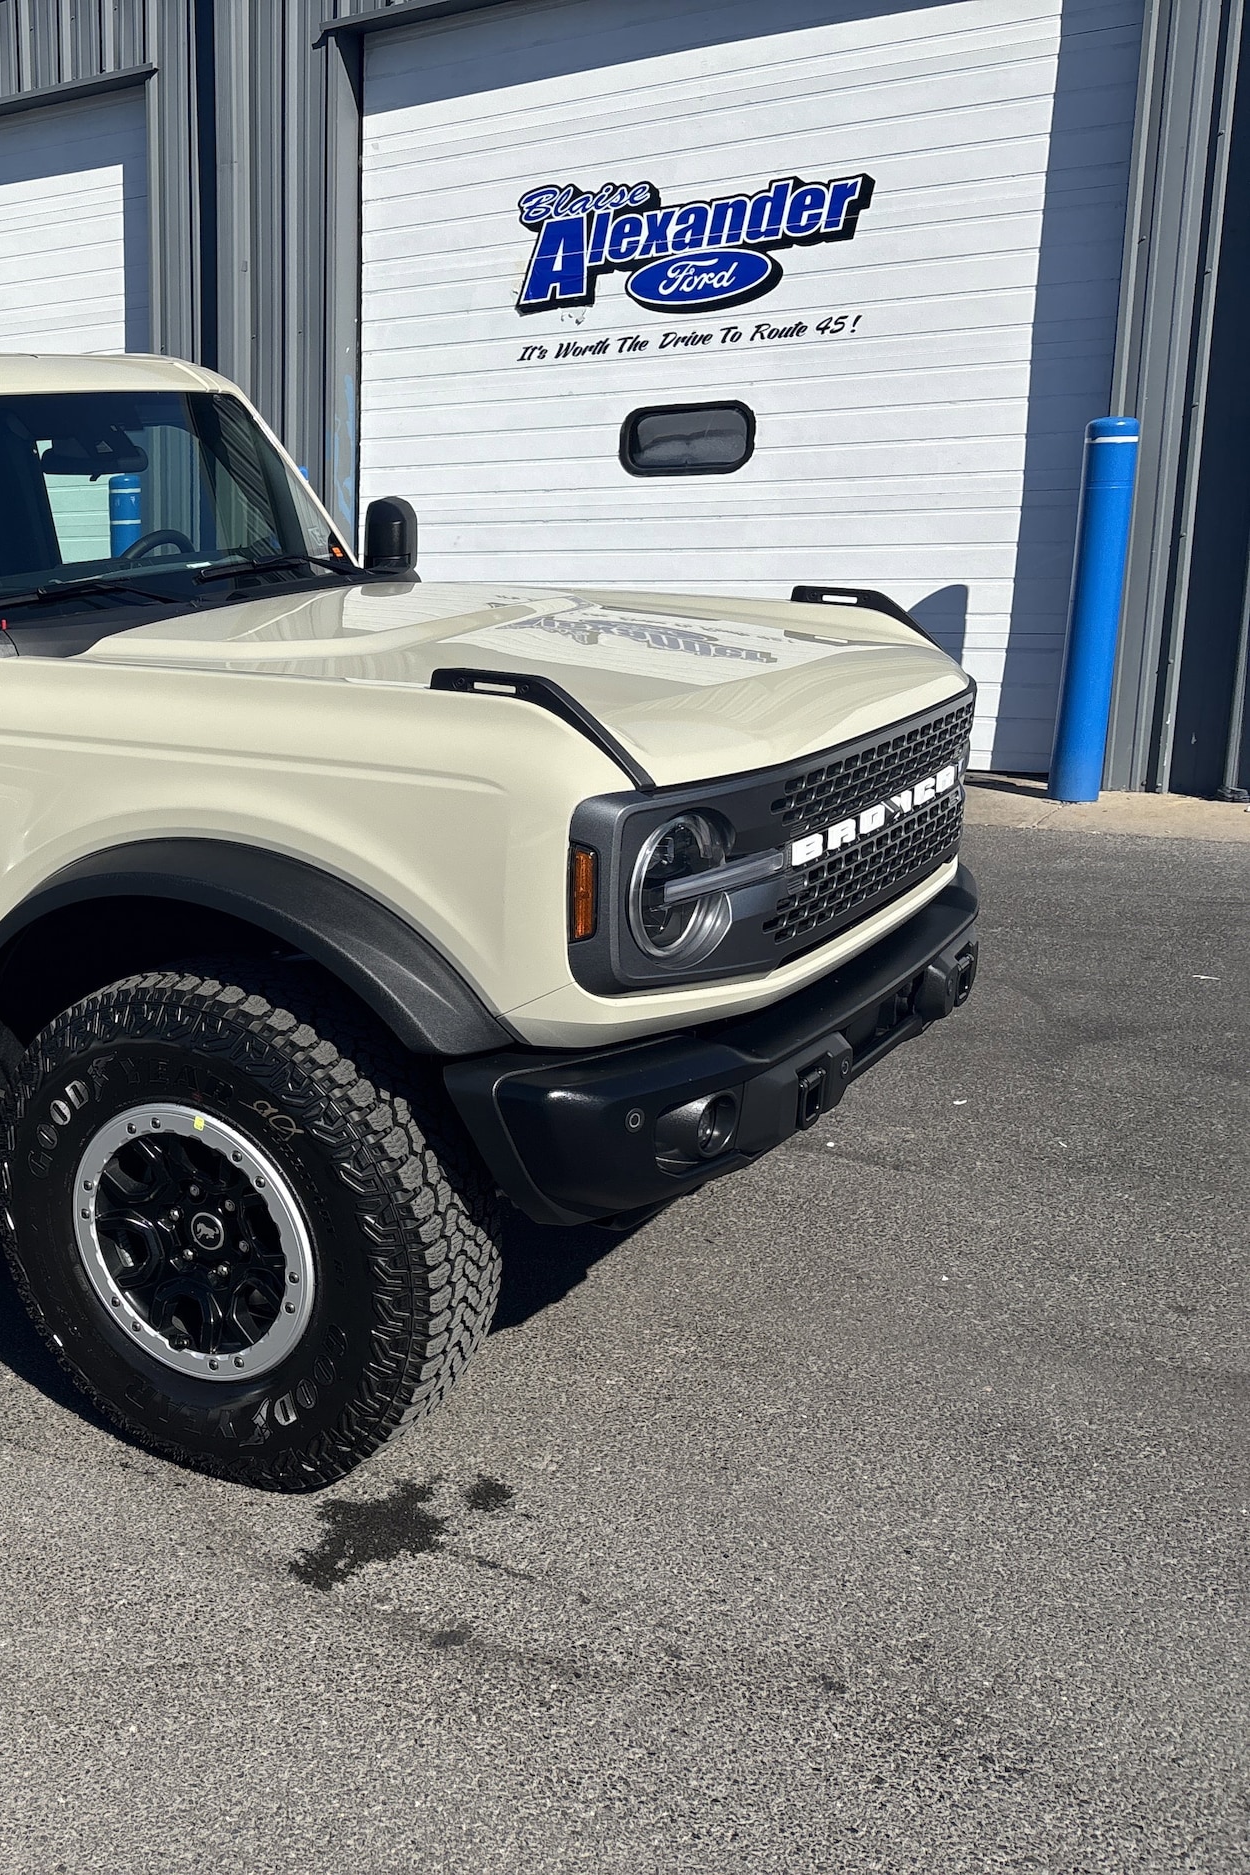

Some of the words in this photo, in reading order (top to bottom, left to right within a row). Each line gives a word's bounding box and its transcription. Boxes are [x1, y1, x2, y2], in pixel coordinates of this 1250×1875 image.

[520, 182, 652, 225] Blaise
[517, 174, 868, 308] Alexander
[657, 257, 737, 297] Ford
[517, 345, 549, 362] It's
[554, 337, 611, 359] Worth
[616, 334, 649, 354] The
[658, 330, 714, 350] Drive
[720, 326, 743, 344] To
[748, 321, 809, 342] Route
[791, 764, 956, 867] BRONCO
